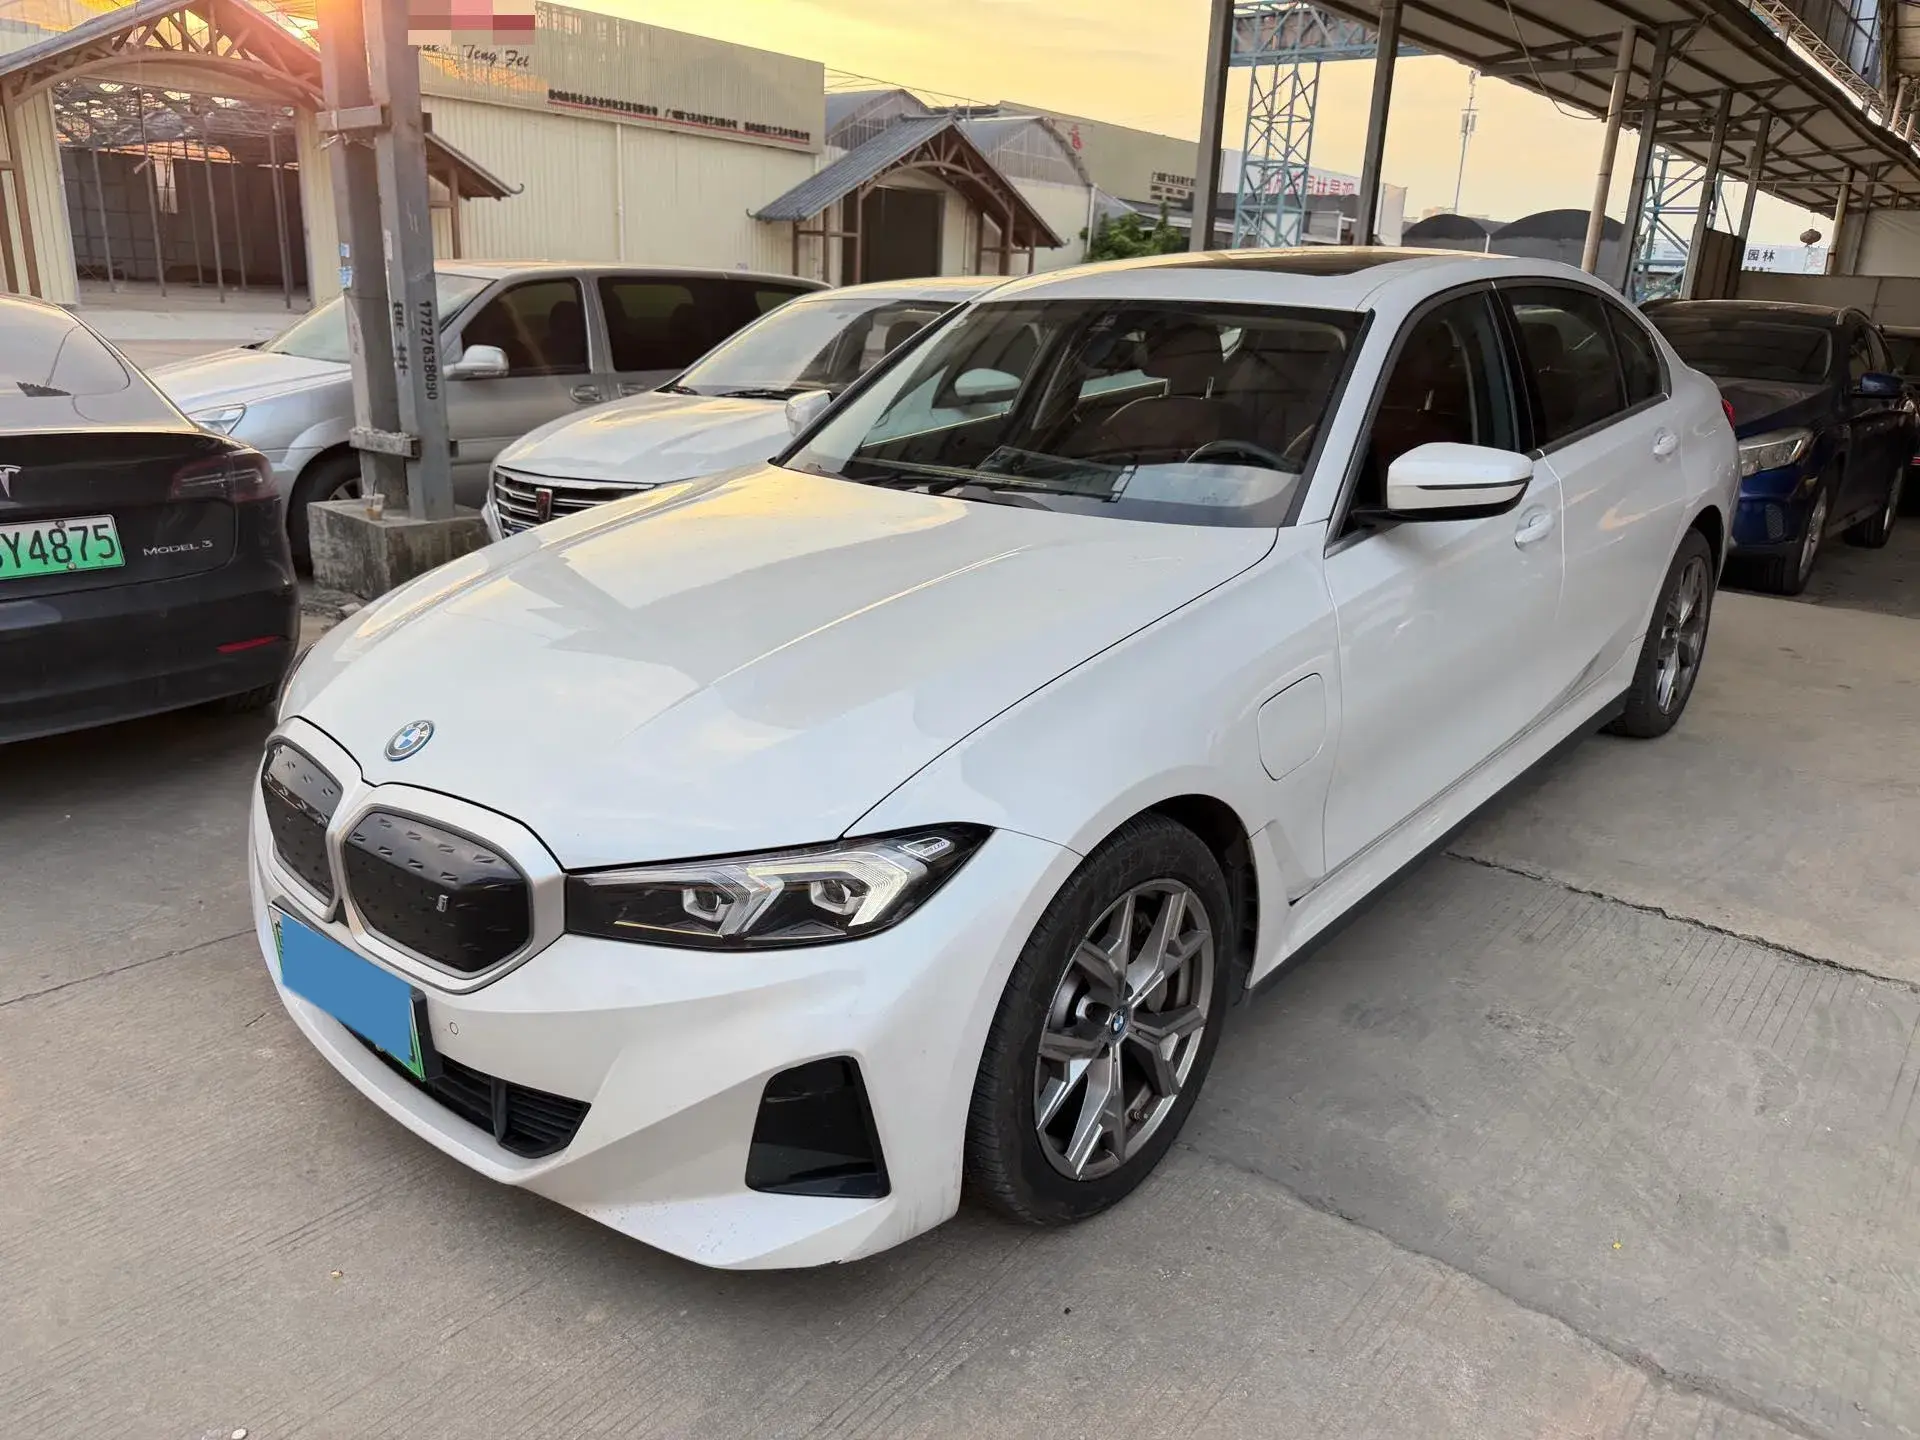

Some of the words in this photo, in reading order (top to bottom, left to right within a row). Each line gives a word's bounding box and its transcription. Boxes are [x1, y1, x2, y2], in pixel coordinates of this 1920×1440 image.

[463, 44, 498, 65] Teng
[504, 50, 530, 68] Fei
[1747, 249, 1776, 263] 园林
[419, 300, 439, 400] 17727638090
[0, 523, 116, 569] Y4875
[142, 543, 200, 556] MODEL
[202, 540, 214, 548] 3
